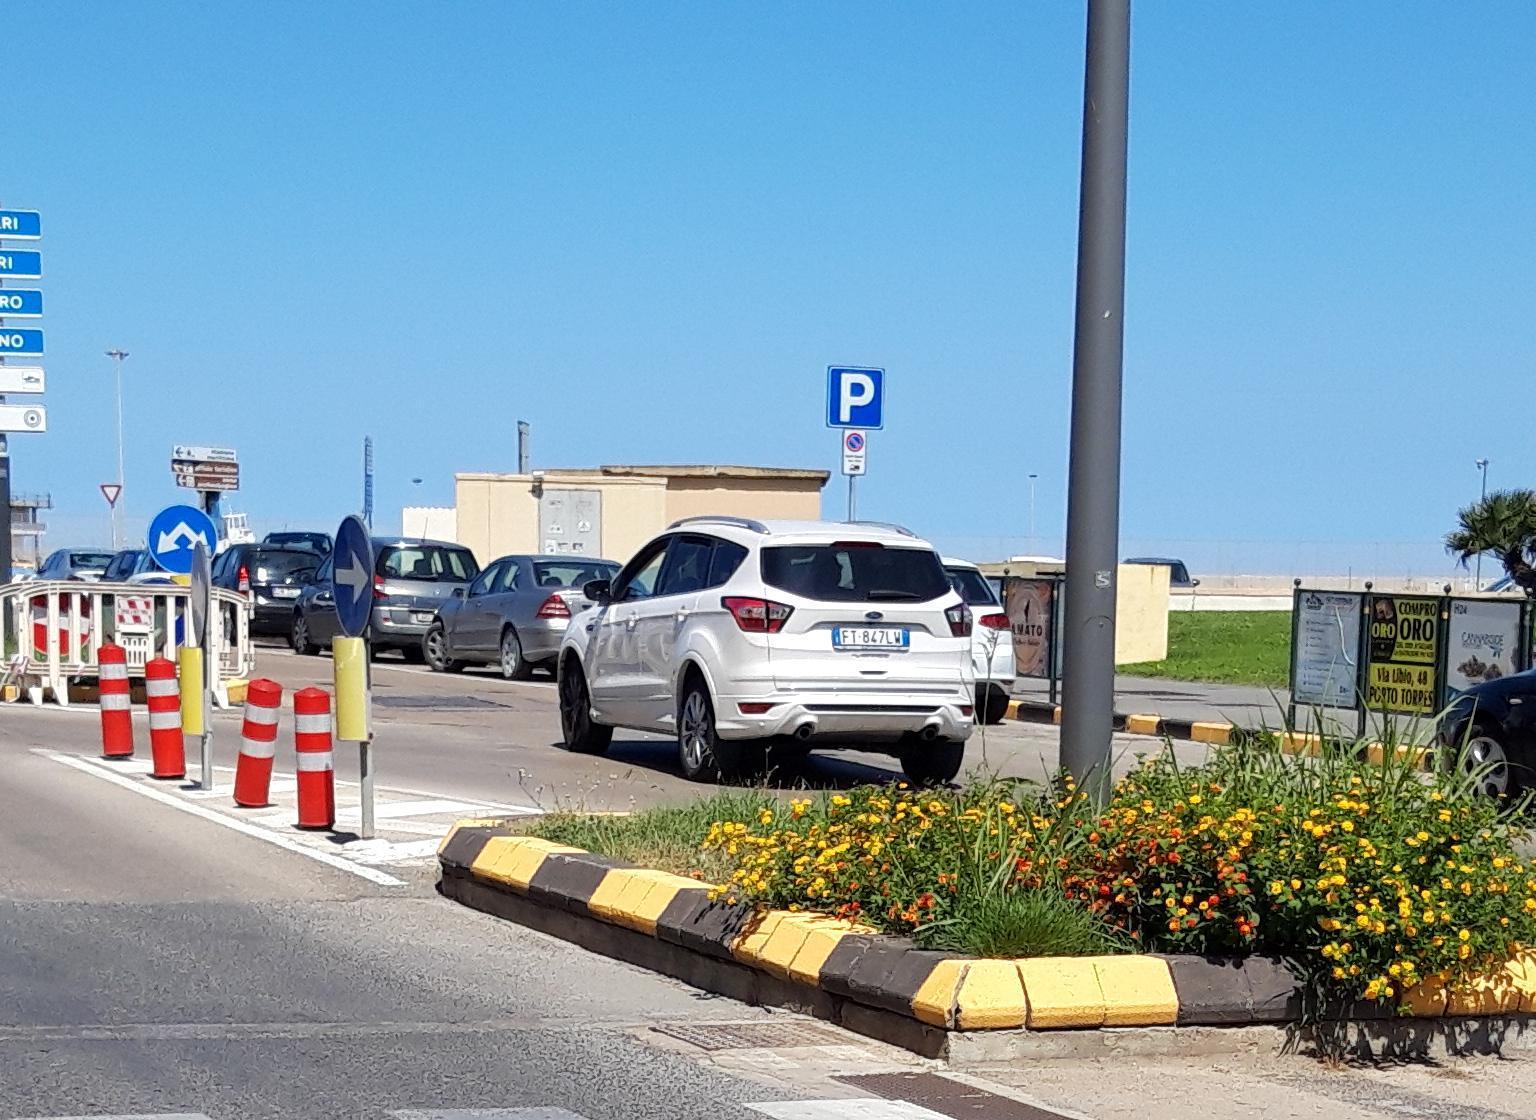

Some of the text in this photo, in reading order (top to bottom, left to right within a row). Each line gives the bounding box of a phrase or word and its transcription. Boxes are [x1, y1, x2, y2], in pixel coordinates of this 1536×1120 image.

[839, 372, 875, 423] P
[1398, 601, 1437, 617] COMPRO
[1372, 622, 1396, 639] ORO
[1400, 618, 1434, 641] ORO
[1377, 667, 1390, 683] Via
[1401, 688, 1434, 708] TORRES
